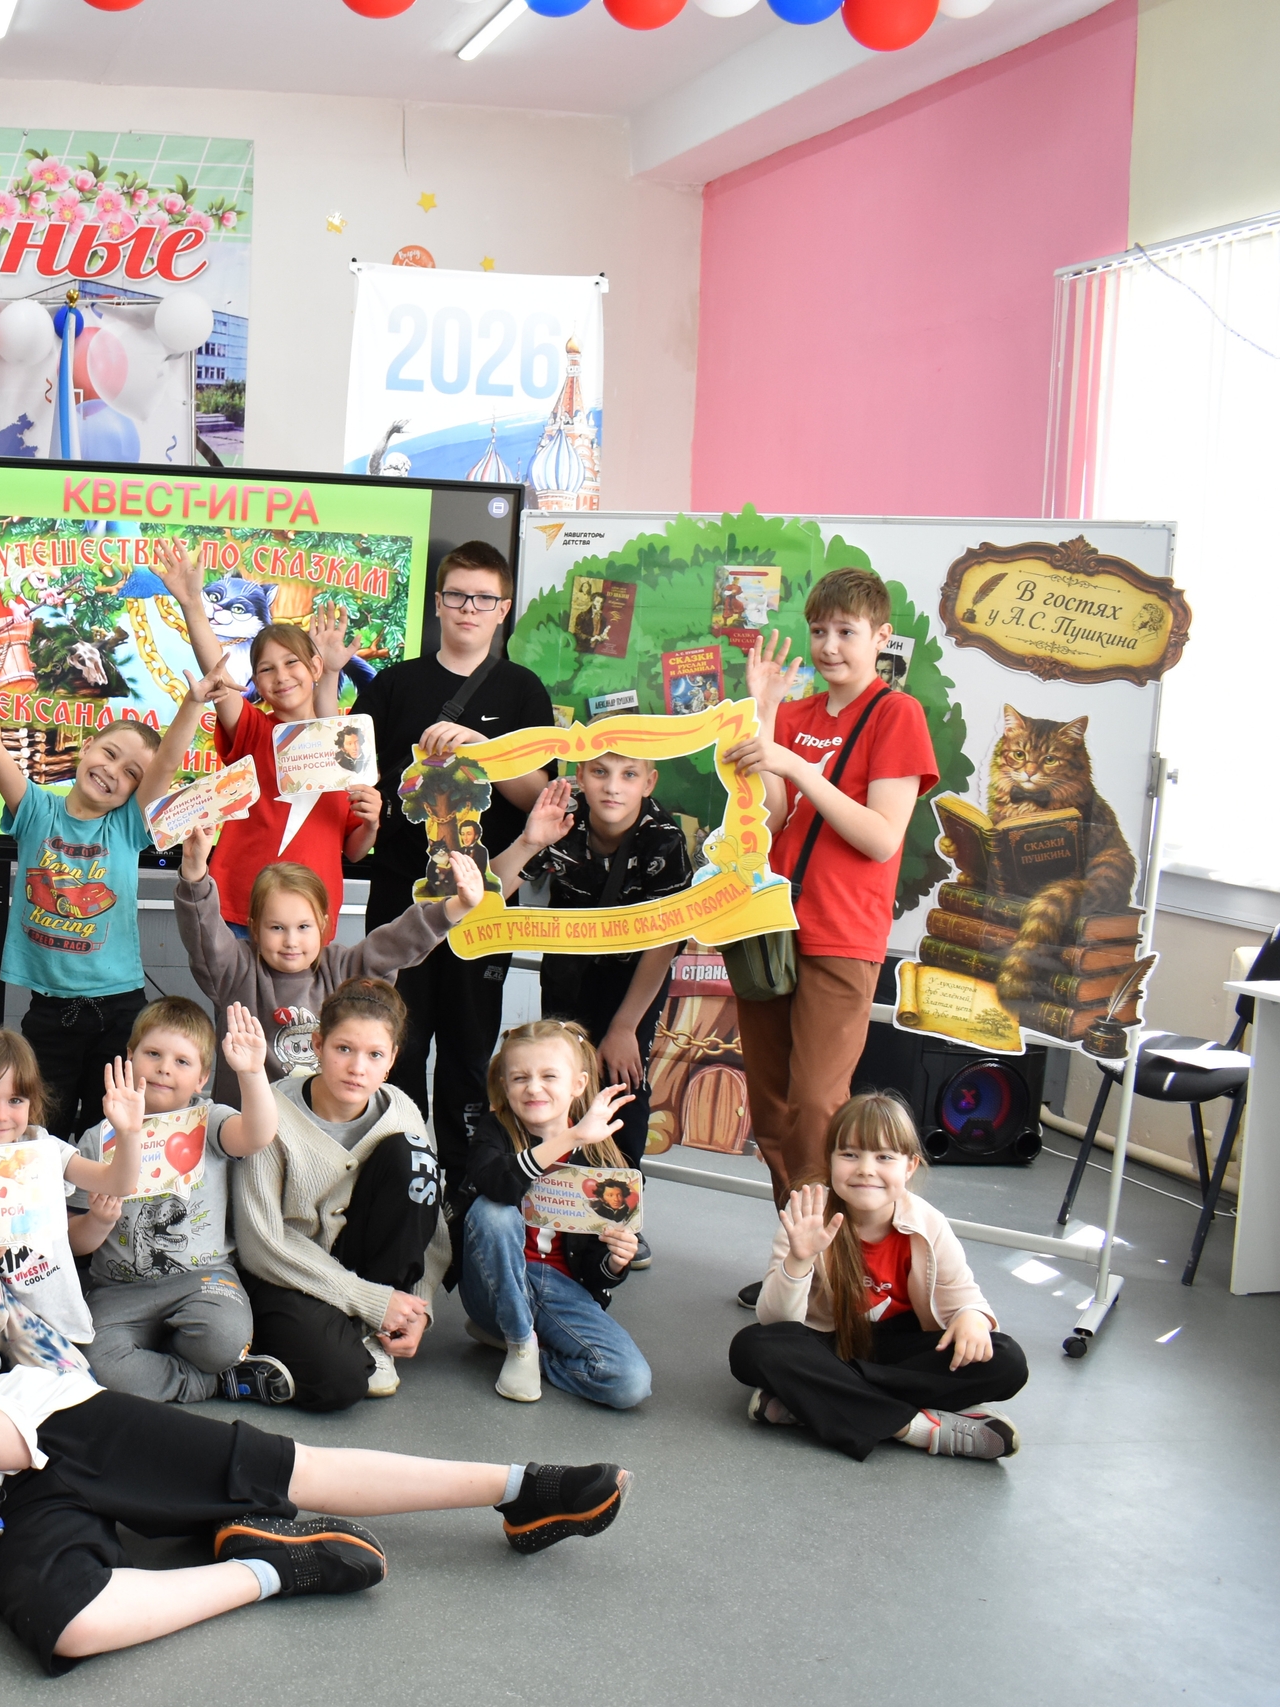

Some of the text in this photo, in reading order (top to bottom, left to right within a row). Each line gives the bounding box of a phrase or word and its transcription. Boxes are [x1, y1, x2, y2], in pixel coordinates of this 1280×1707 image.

[385, 304, 561, 400] 2026
[62, 476, 320, 525] КВЕСТ-ИГРА
[203, 538, 240, 569] ПО
[252, 545, 389, 598] СКАЗКАМ
[1016, 580, 1122, 620] В гостях
[984, 609, 999, 626] у
[1051, 616, 1138, 650] Пушкина
[668, 652, 713, 665] СКАЗКИ
[298, 741, 322, 750] ИЮНЯ
[281, 750, 335, 763] ПУШКИНСКИЙ
[282, 765, 301, 773] ДЕНЬ
[163, 794, 201, 815] ВЕЛИКИЙ
[173, 796, 213, 818] МОГУЧИЙ
[166, 806, 205, 827] РУССКИЙ
[168, 818, 190, 832] ЯЗЫК
[1024, 837, 1065, 852] СКАЗКИ
[1021, 849, 1071, 865] ПУШКИНА
[29, 906, 96, 938] Racing
[476, 922, 501, 942] КОТ
[63, 941, 87, 951] RACE
[925, 987, 940, 996] дуб
[534, 1176, 573, 1189] ЛЮБИТЕ
[534, 1194, 576, 1207] ЧИТАЙТЕ
[534, 1204, 585, 1218] ПУШКИНА!
[24, 1275, 45, 1286] COOL
